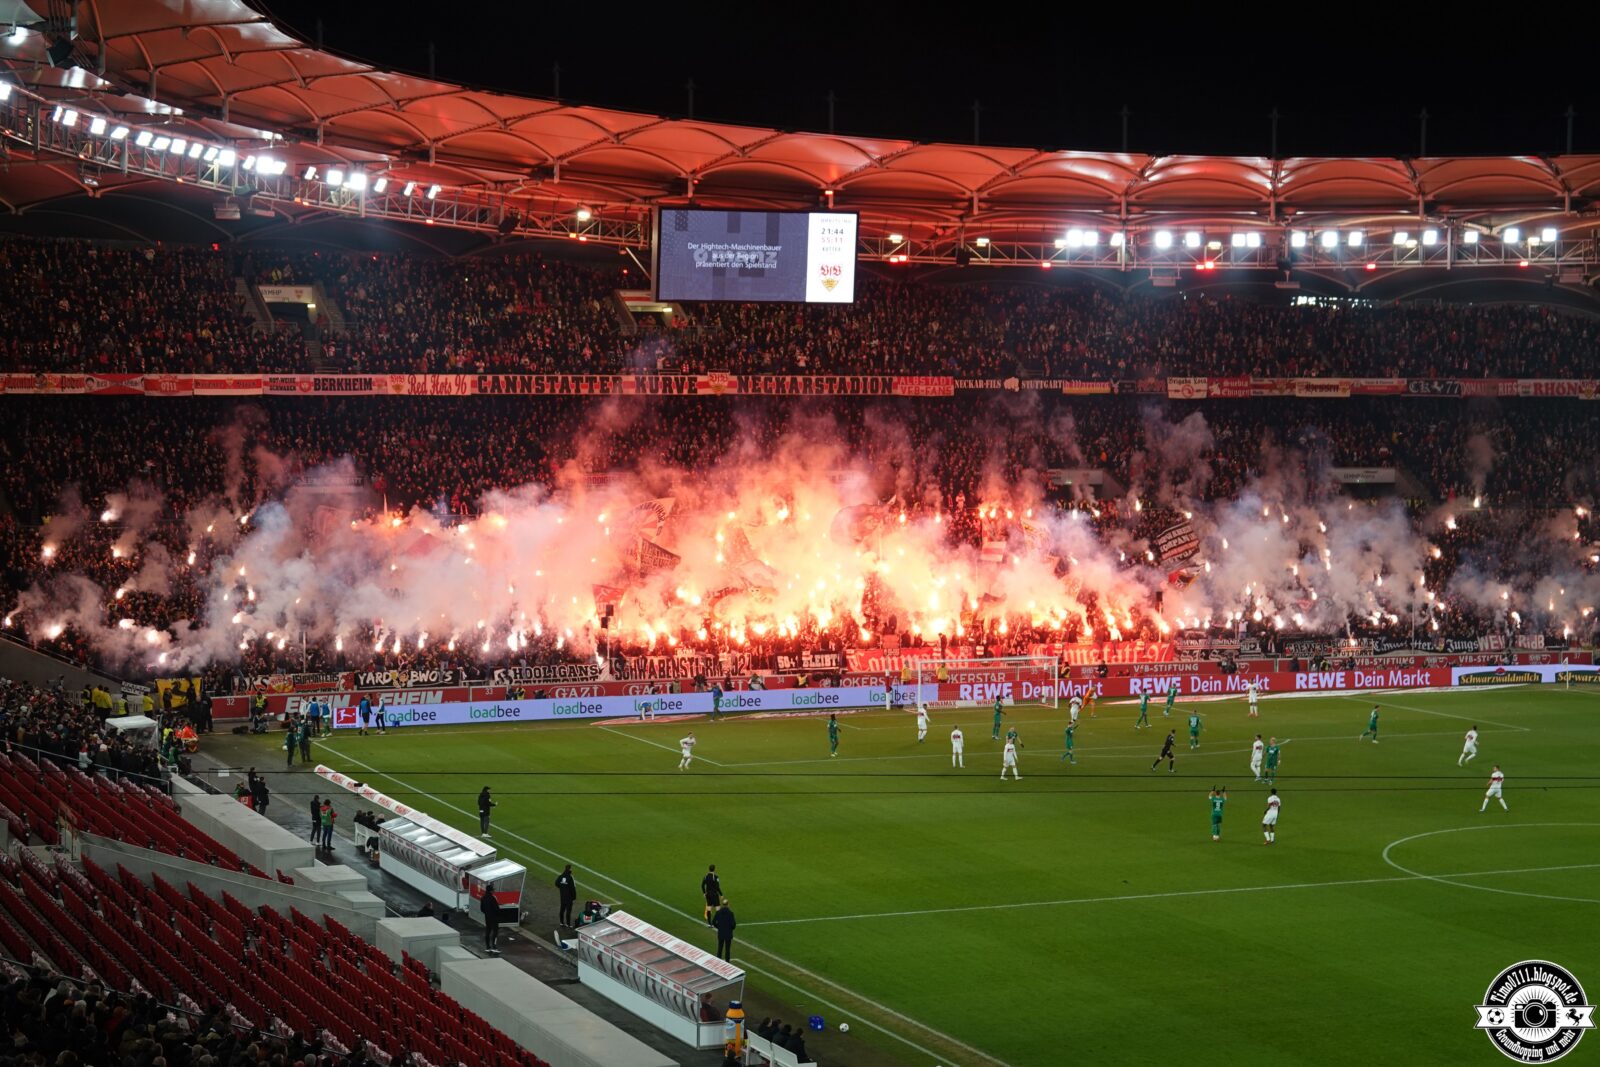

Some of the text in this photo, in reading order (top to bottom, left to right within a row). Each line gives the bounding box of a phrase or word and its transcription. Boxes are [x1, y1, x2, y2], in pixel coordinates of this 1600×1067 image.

[821, 227, 844, 235] 21:44
[687, 242, 782, 252] Der Hightech-Maschinenbauer
[695, 260, 732, 269] präsentiert
[745, 261, 777, 269] Spielstand
[313, 377, 373, 392] BERKHEIM
[408, 374, 467, 395] Red Hots 96
[477, 376, 698, 394] CANNSTATTER KURVE
[736, 376, 894, 394] NECKARSTADION
[900, 377, 952, 386] ALBSTADT
[1021, 378, 1063, 389] STUTTGART
[1445, 638, 1479, 653] Jungs
[1031, 643, 1139, 665] Cnnstatt
[512, 665, 599, 680] HOOLIGANS
[1133, 663, 1199, 673] VfB-STIFTUNG
[358, 672, 392, 685] YARD
[959, 683, 1013, 700] REWE
[1022, 680, 1054, 699] Dein
[1059, 679, 1103, 697] Markt
[1130, 676, 1181, 695] REWE
[1191, 676, 1228, 692] Dein
[1296, 672, 1346, 689] REWE
[1354, 671, 1384, 688] Dein
[1388, 669, 1431, 687] Markt
[1460, 673, 1540, 685] Schwarzwaldmilch
[226, 698, 235, 706] 32
[384, 708, 437, 724] loadbee
[469, 705, 520, 719] loadbee
[552, 702, 603, 716] loadbee
[634, 697, 683, 712] lodbee
[719, 695, 761, 708] oadbee
[792, 687, 839, 705] loadbee
